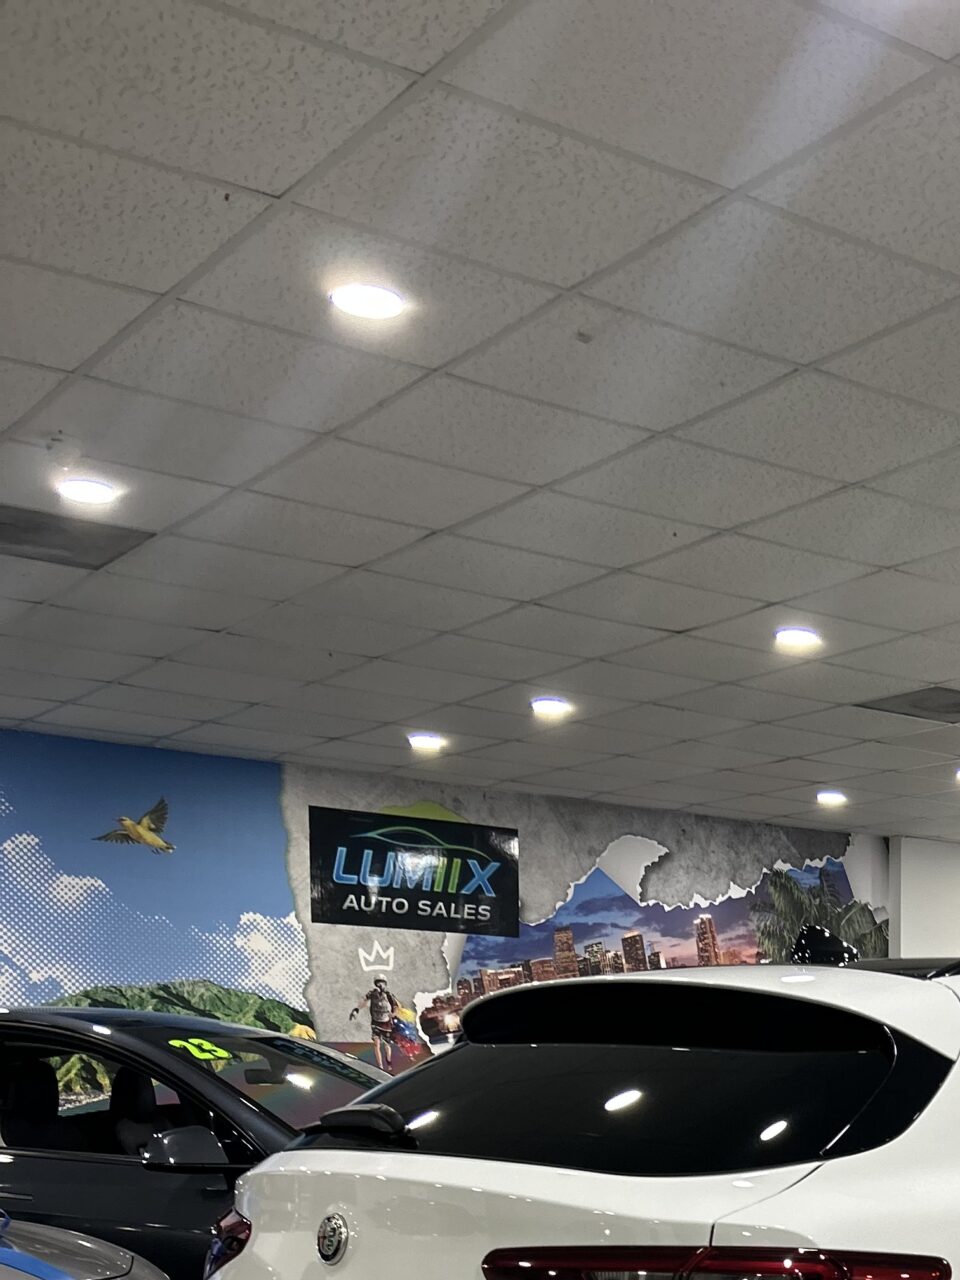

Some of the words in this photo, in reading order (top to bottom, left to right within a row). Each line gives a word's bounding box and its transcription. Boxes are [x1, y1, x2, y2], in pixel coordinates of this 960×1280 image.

[332, 846, 500, 898] LUMIIX
[342, 894, 409, 914] AUTO
[417, 900, 491, 921] SALES
[168, 1038, 232, 1060] 23
